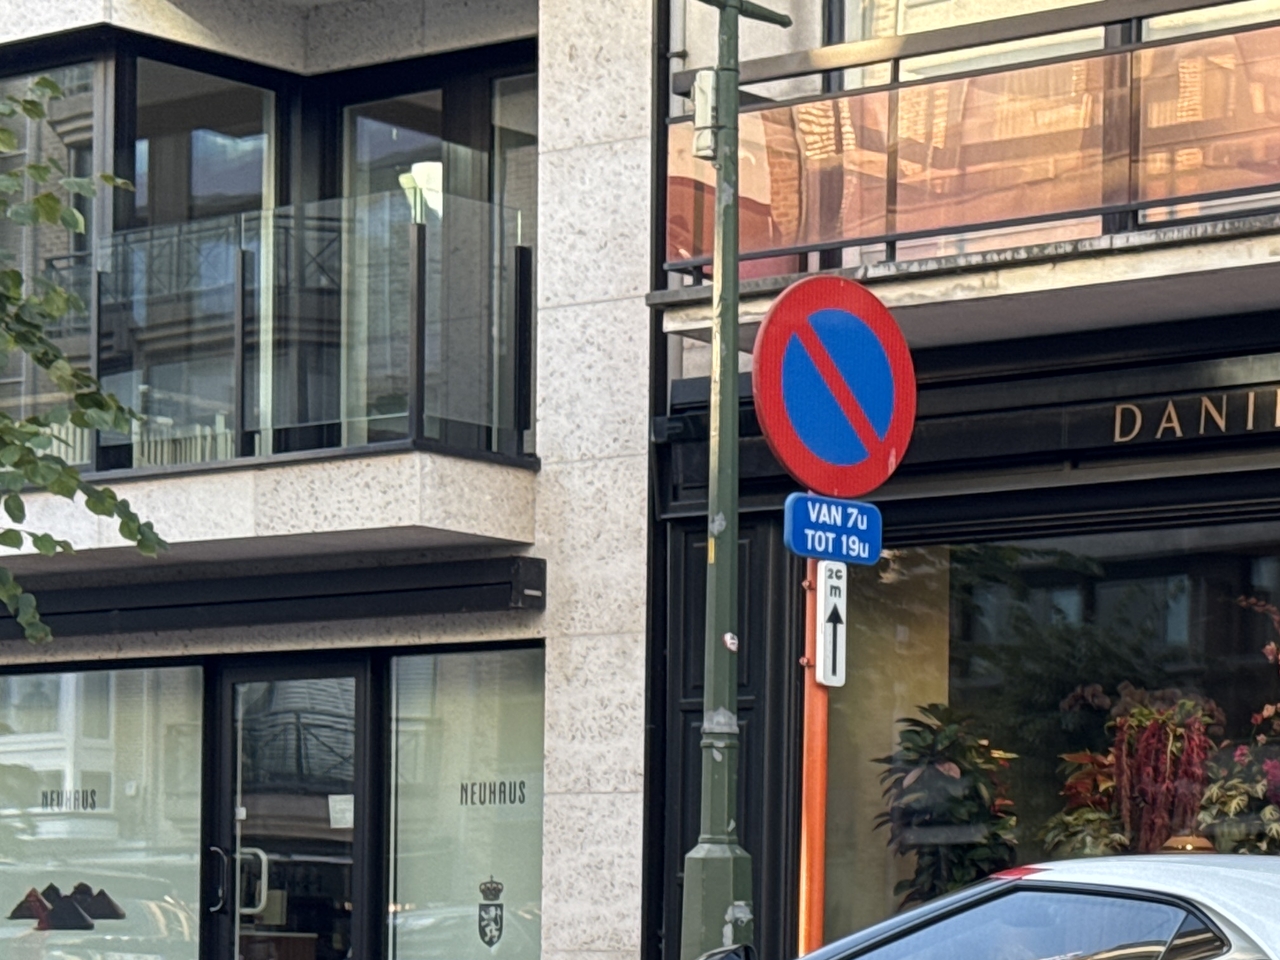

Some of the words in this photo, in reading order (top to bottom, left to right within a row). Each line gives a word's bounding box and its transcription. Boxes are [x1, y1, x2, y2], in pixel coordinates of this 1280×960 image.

[807, 501, 842, 527] VAN
[846, 507, 867, 530] 7u
[804, 528, 836, 553] TOT
[841, 534, 869, 558] 19u
[830, 585, 841, 598] m
[41, 789, 97, 811] NEUHAUS
[460, 780, 526, 806] NEUHAUS
